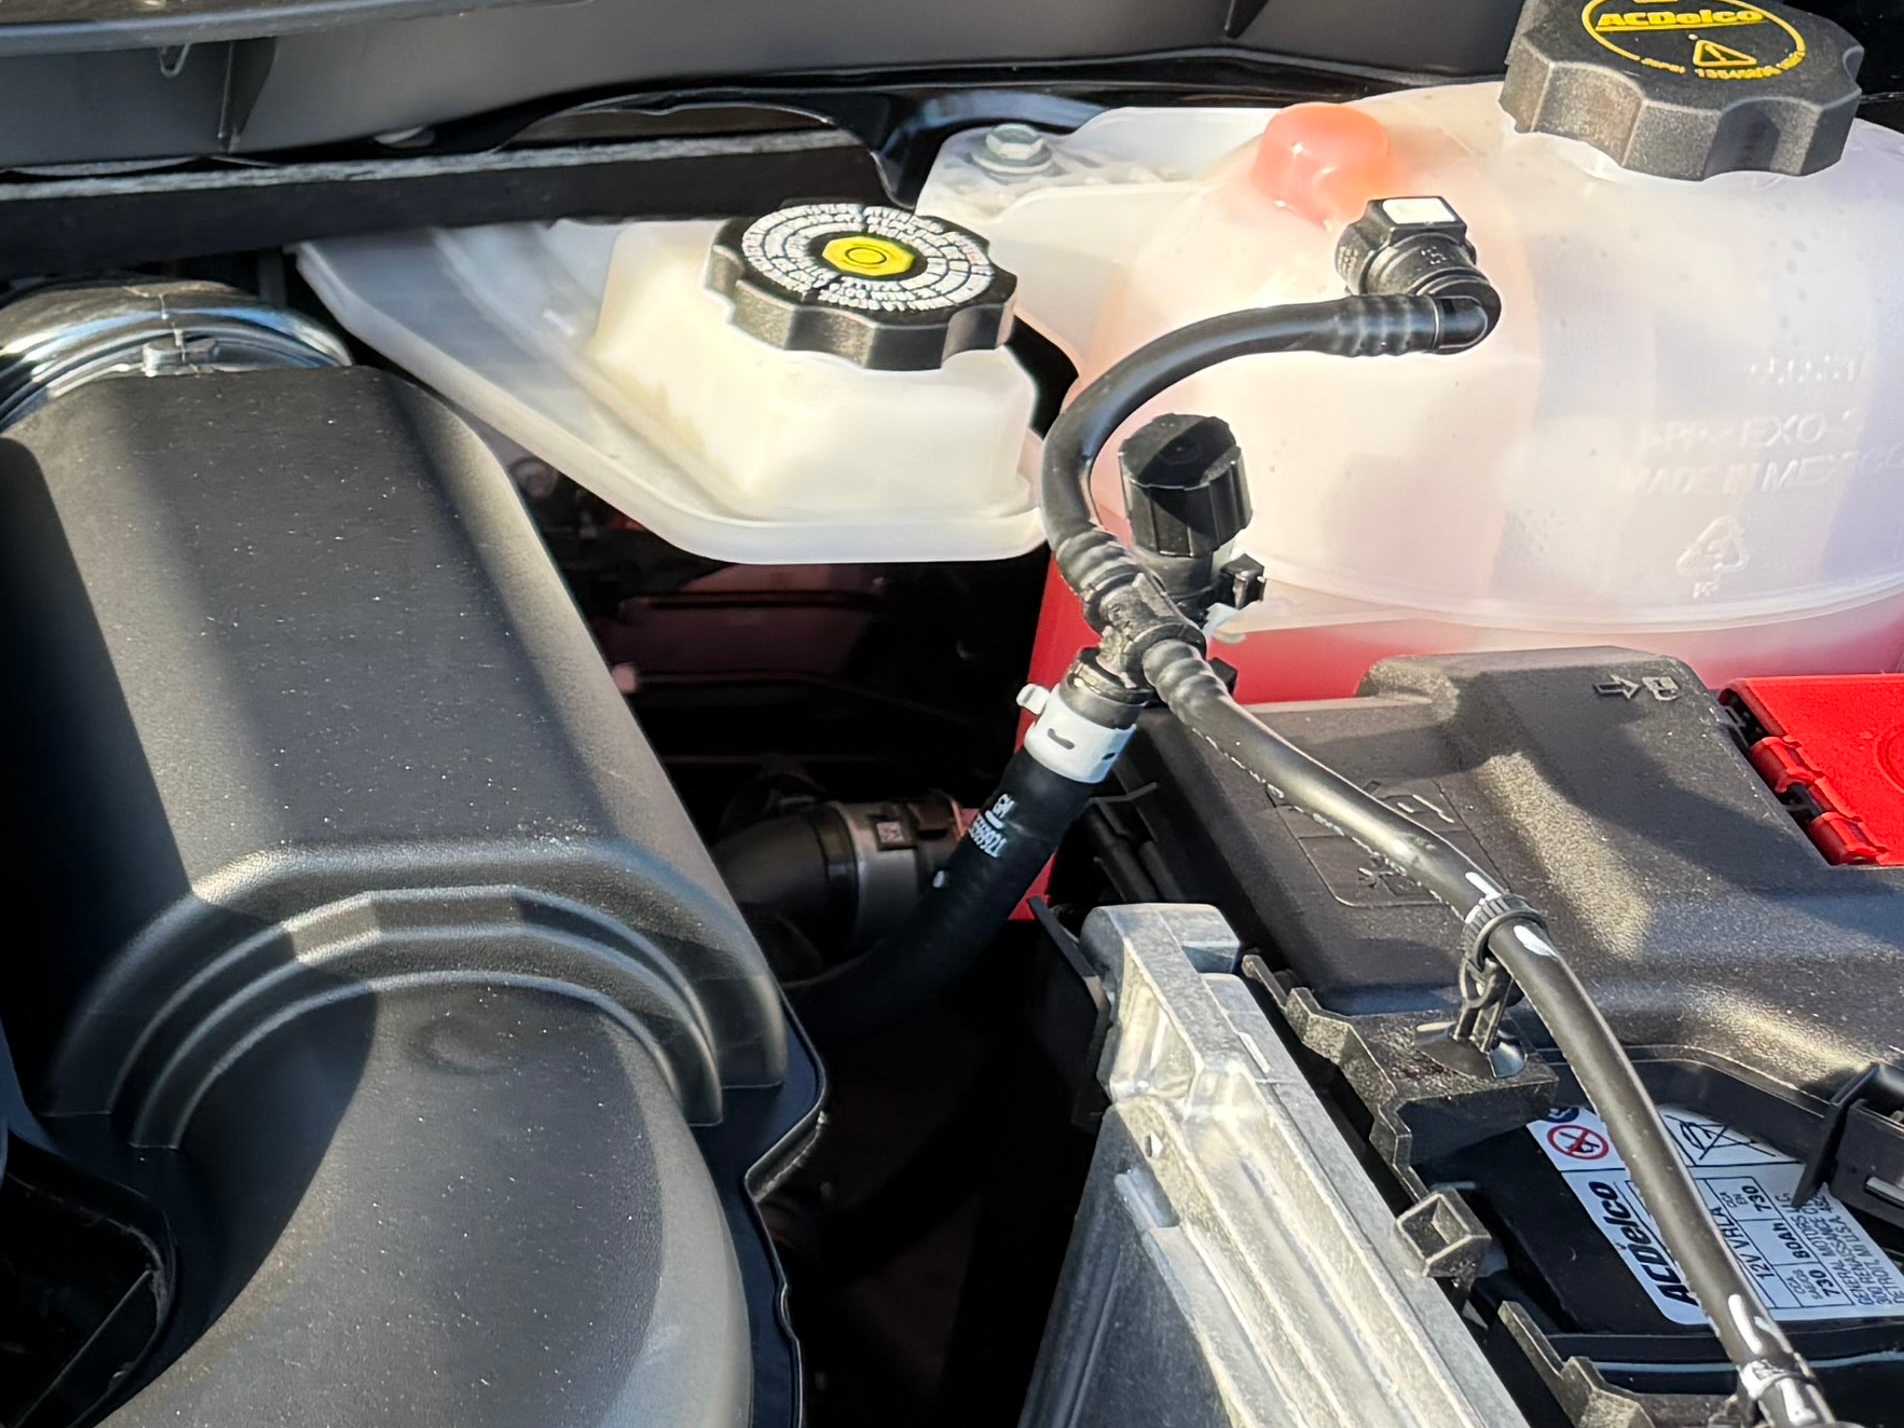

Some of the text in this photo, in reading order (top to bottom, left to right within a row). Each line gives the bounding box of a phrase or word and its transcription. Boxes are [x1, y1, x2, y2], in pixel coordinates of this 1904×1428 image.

[1596, 9, 1764, 29] ACDelco
[1741, 1185, 1772, 1212] 730
[1588, 1181, 1700, 1307] ACDelco
[1772, 1222, 1811, 1259] 80Ah
[1739, 1253, 1775, 1280] 12V
[1808, 1269, 1841, 1297] 730
